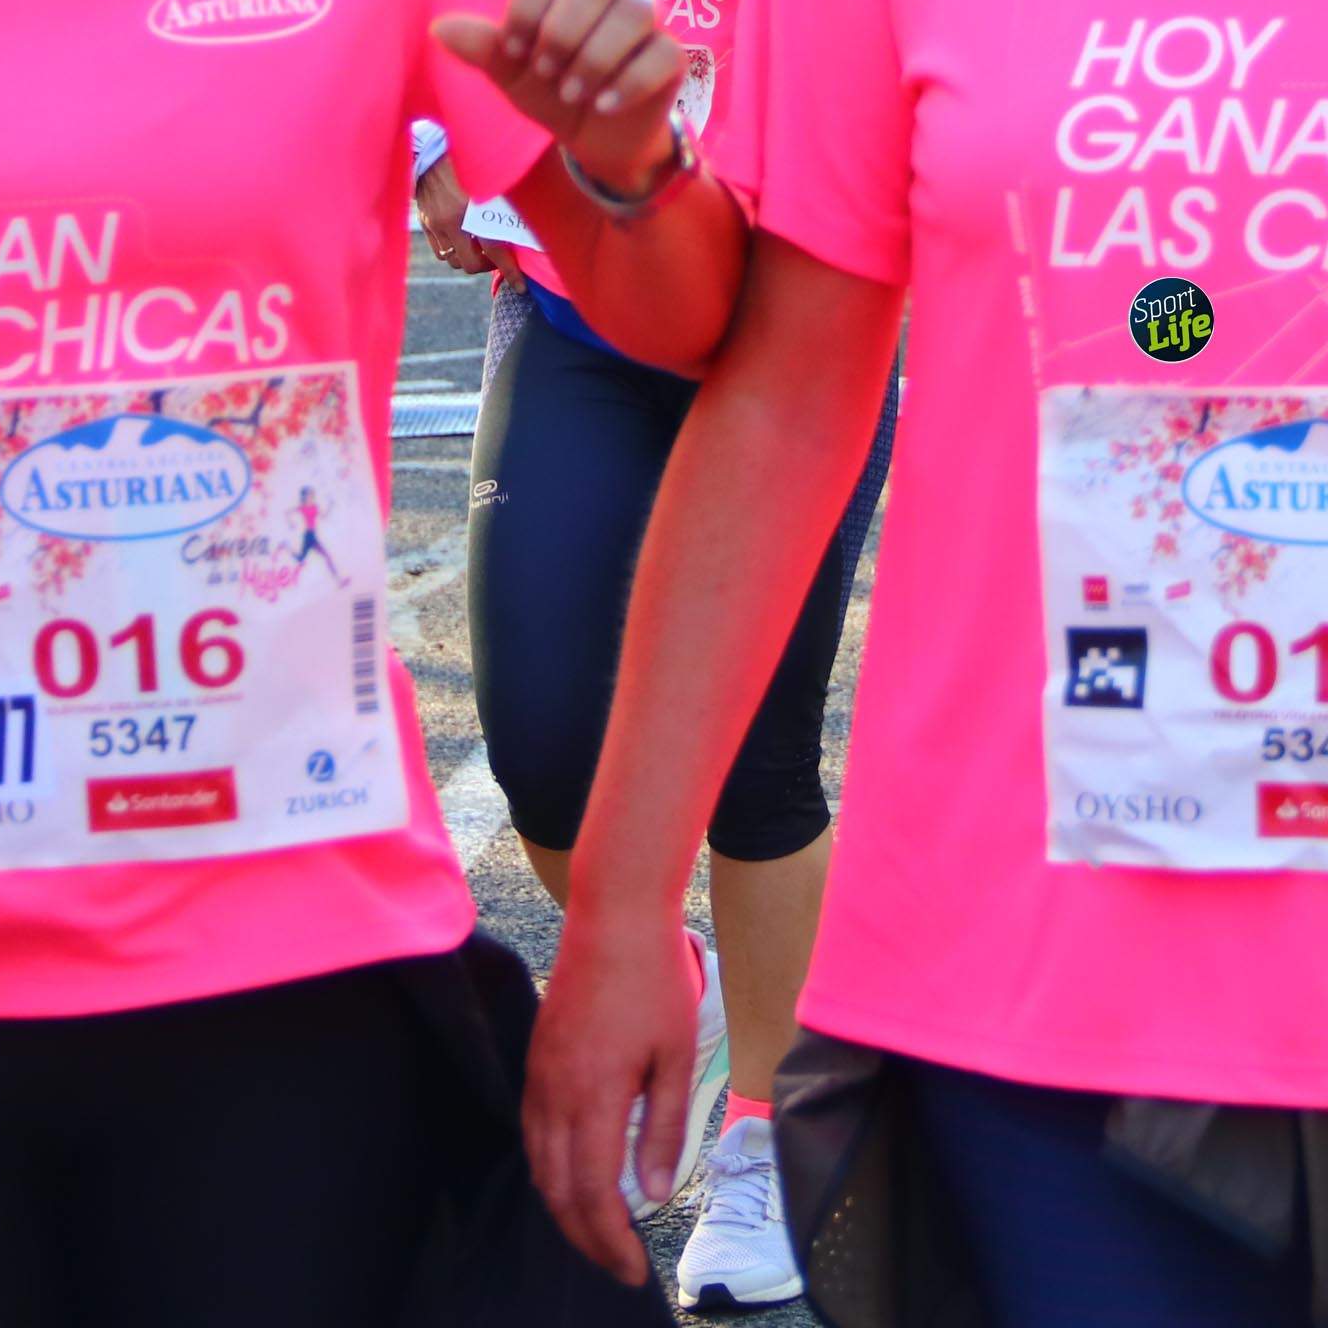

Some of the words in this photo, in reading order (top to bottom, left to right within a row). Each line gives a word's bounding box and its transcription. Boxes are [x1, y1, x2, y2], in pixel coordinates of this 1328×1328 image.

[1069, 15, 1285, 91] HOY
[1048, 184, 1218, 269] LAS
[20, 466, 235, 512] ASTURIANA
[181, 534, 270, 565] Carrera
[32, 606, 245, 700] 016
[89, 714, 198, 758] 5347
[129, 788, 221, 811] Santander
[285, 787, 369, 817] ZURICH
[1074, 789, 1204, 824] OYSHO
